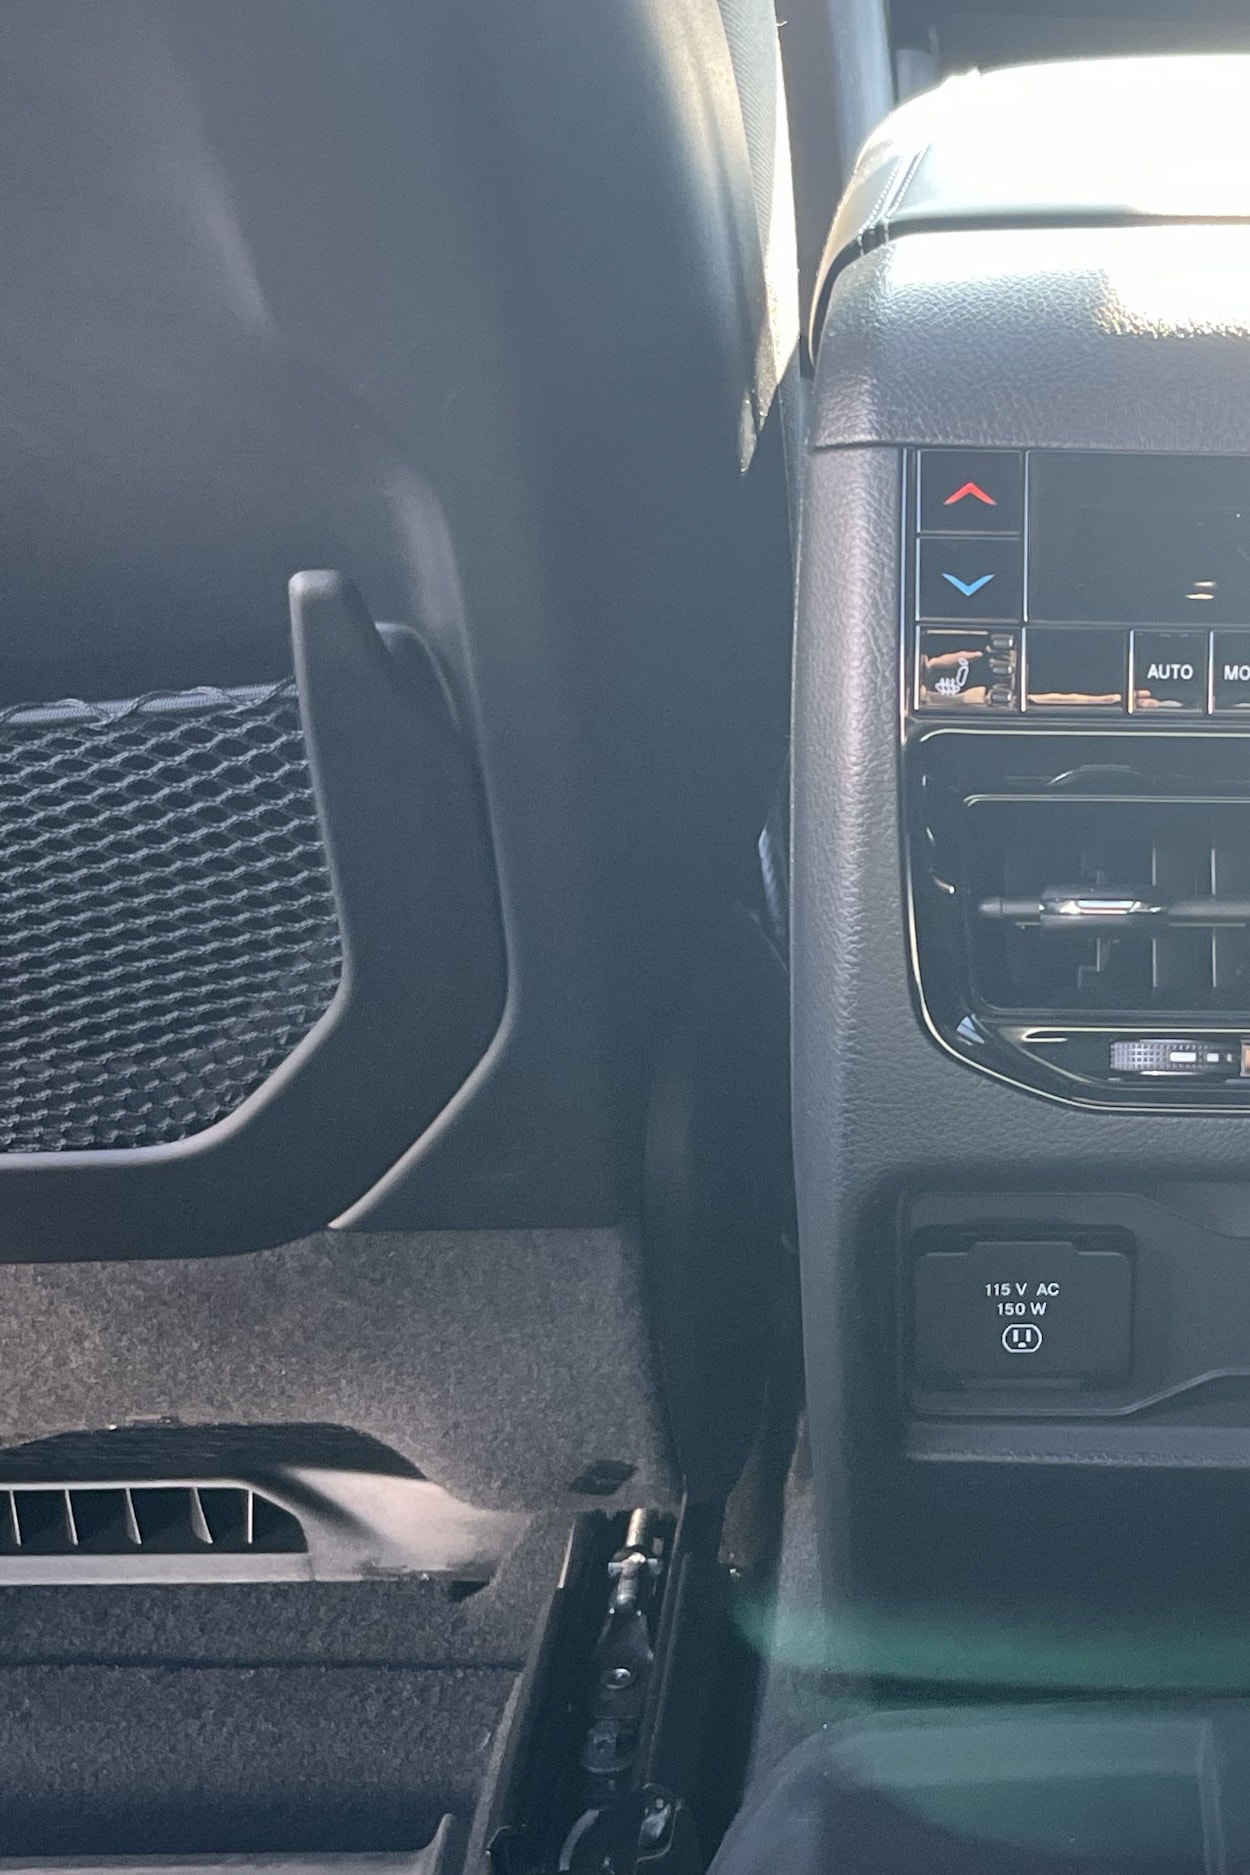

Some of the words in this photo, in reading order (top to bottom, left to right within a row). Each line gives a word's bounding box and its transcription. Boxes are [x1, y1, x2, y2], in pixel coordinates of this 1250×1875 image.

[1147, 663, 1193, 680] AUTO
[985, 1283, 1011, 1296] 115
[1015, 1282, 1028, 1296] V
[1036, 1282, 1060, 1296] AC
[997, 1302, 1026, 1316] 150
[1030, 1302, 1047, 1316] W
